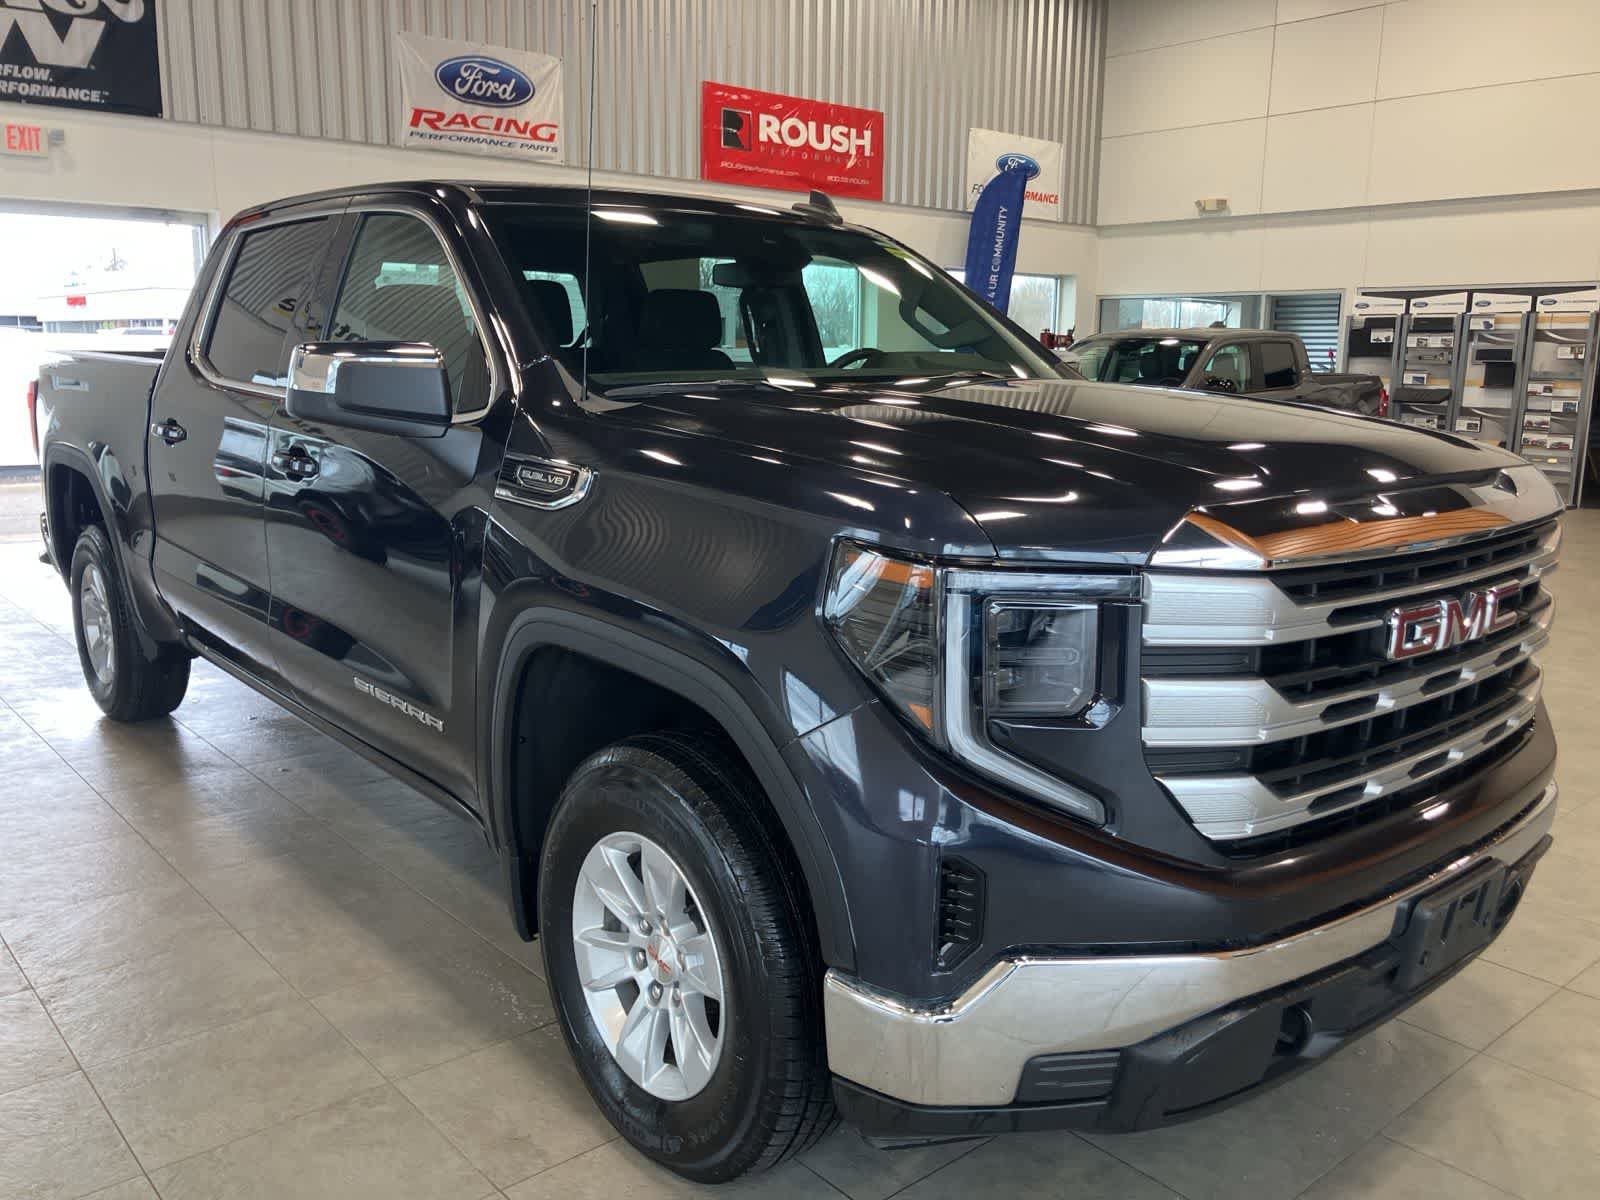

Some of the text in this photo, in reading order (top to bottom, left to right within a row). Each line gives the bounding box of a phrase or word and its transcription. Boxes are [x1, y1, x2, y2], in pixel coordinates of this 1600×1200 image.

[455, 62, 516, 101] Ford
[6, 124, 41, 151] EXIT
[409, 107, 559, 142] RACING
[409, 131, 559, 153] PERFORMANCE PARTS
[758, 113, 872, 158] ROUSH
[991, 205, 1009, 272] COMMUNITY
[1387, 579, 1521, 661] GMC
[353, 676, 444, 732] SIERRA
